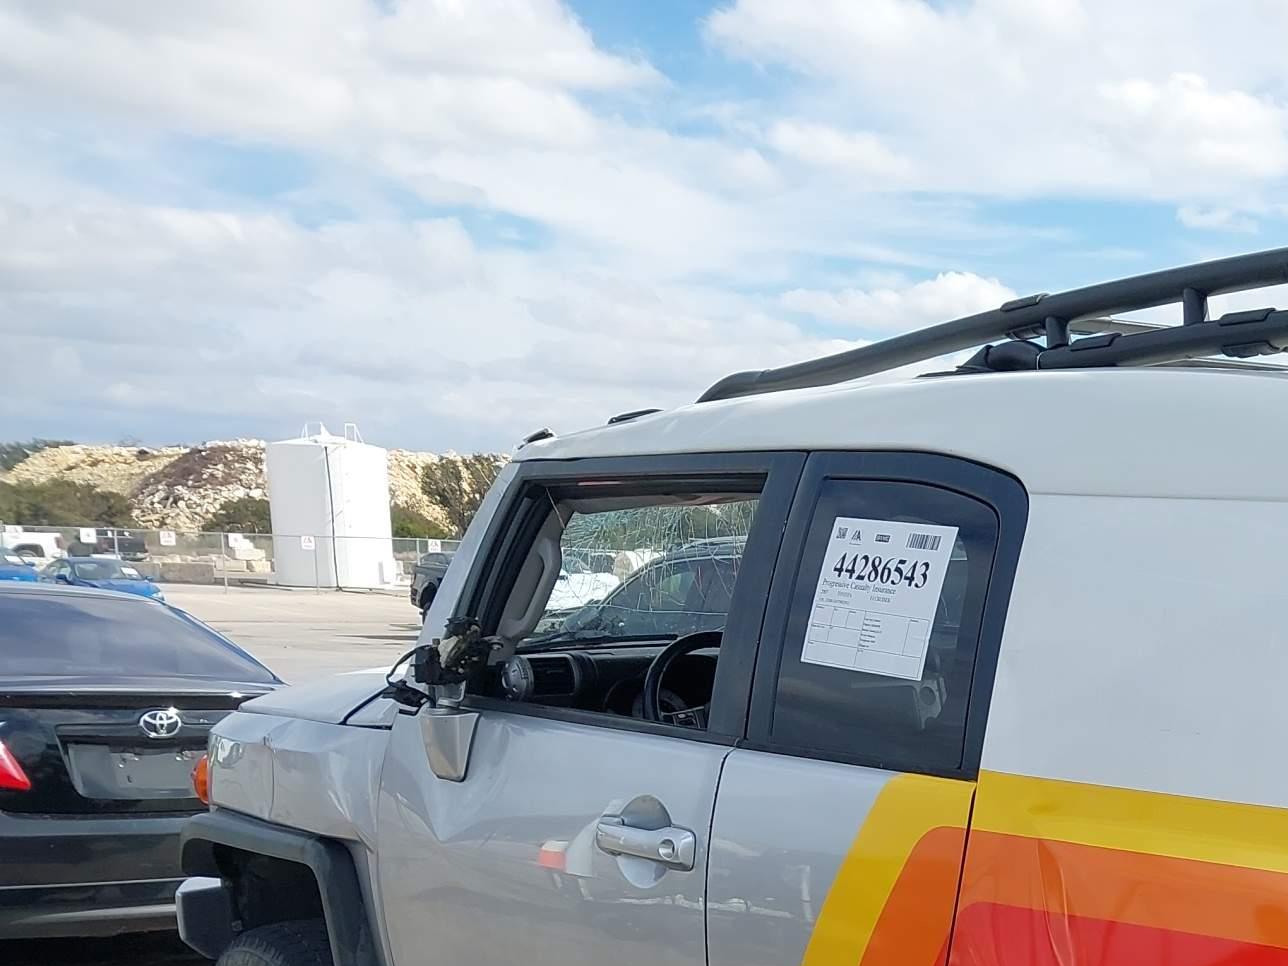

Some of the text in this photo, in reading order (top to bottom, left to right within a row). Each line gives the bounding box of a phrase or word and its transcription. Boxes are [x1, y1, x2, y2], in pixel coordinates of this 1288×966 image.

[833, 552, 930, 588] 44286543
[822, 578, 896, 595] Progressive Casualty Insurance
